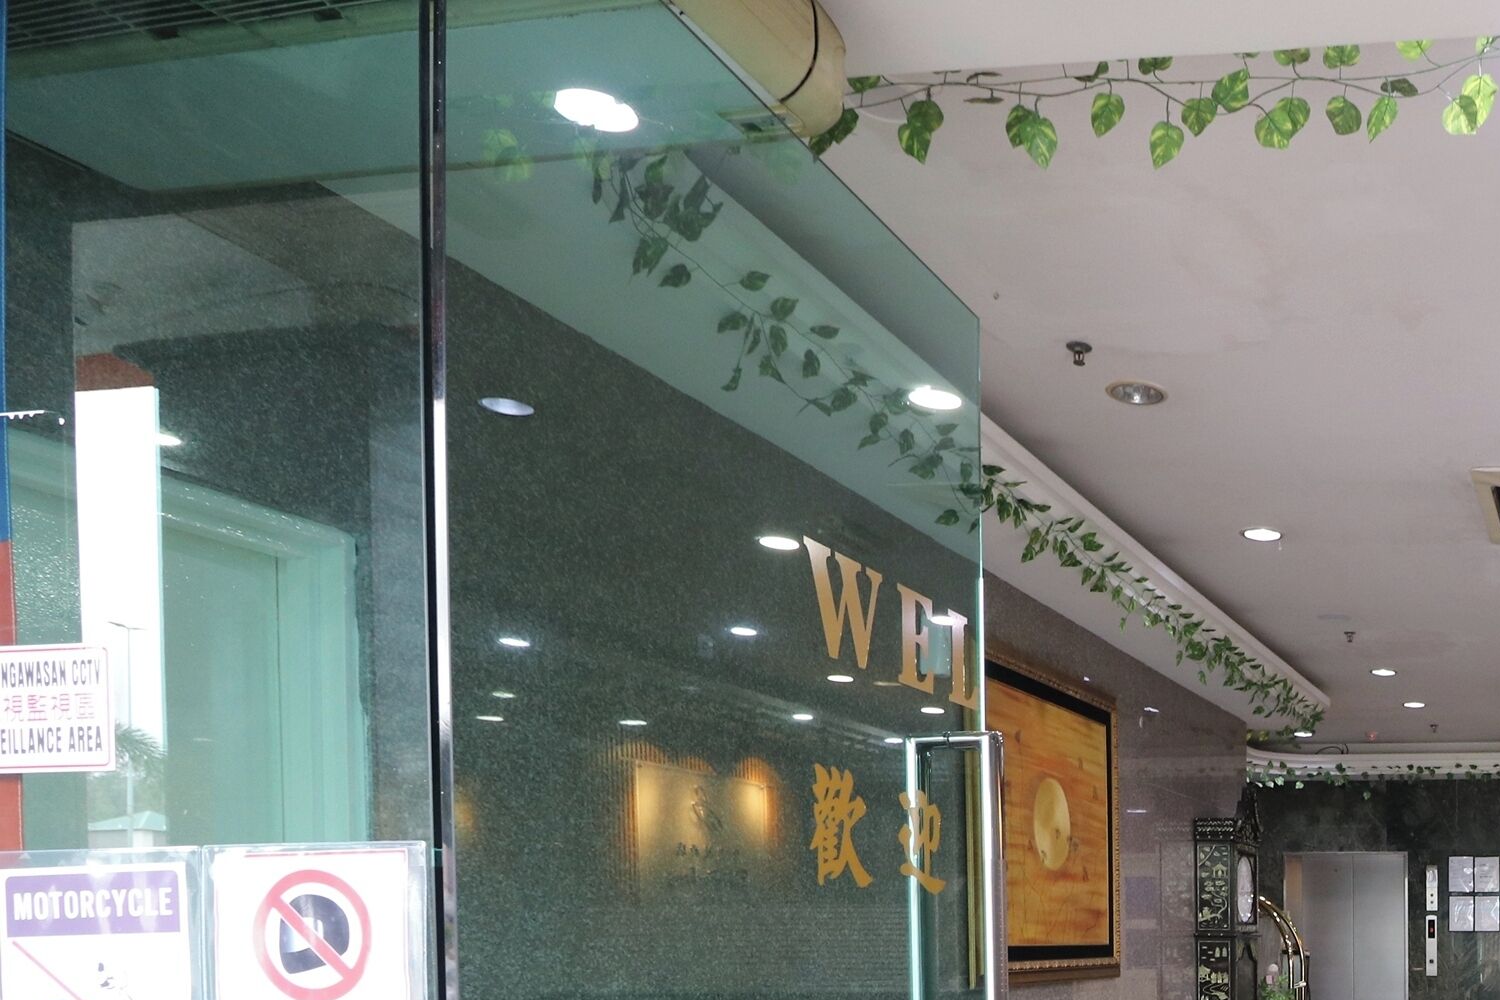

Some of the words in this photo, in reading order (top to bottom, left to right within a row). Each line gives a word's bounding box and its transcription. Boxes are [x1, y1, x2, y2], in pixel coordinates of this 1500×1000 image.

[803, 535, 979, 710] WEL
[1, 660, 67, 688] NGAWASAN
[71, 659, 100, 686] CCTV
[0, 727, 62, 754] EILLANCE
[68, 725, 102, 752] AREA
[13, 887, 174, 921] MOTORCYCLE
